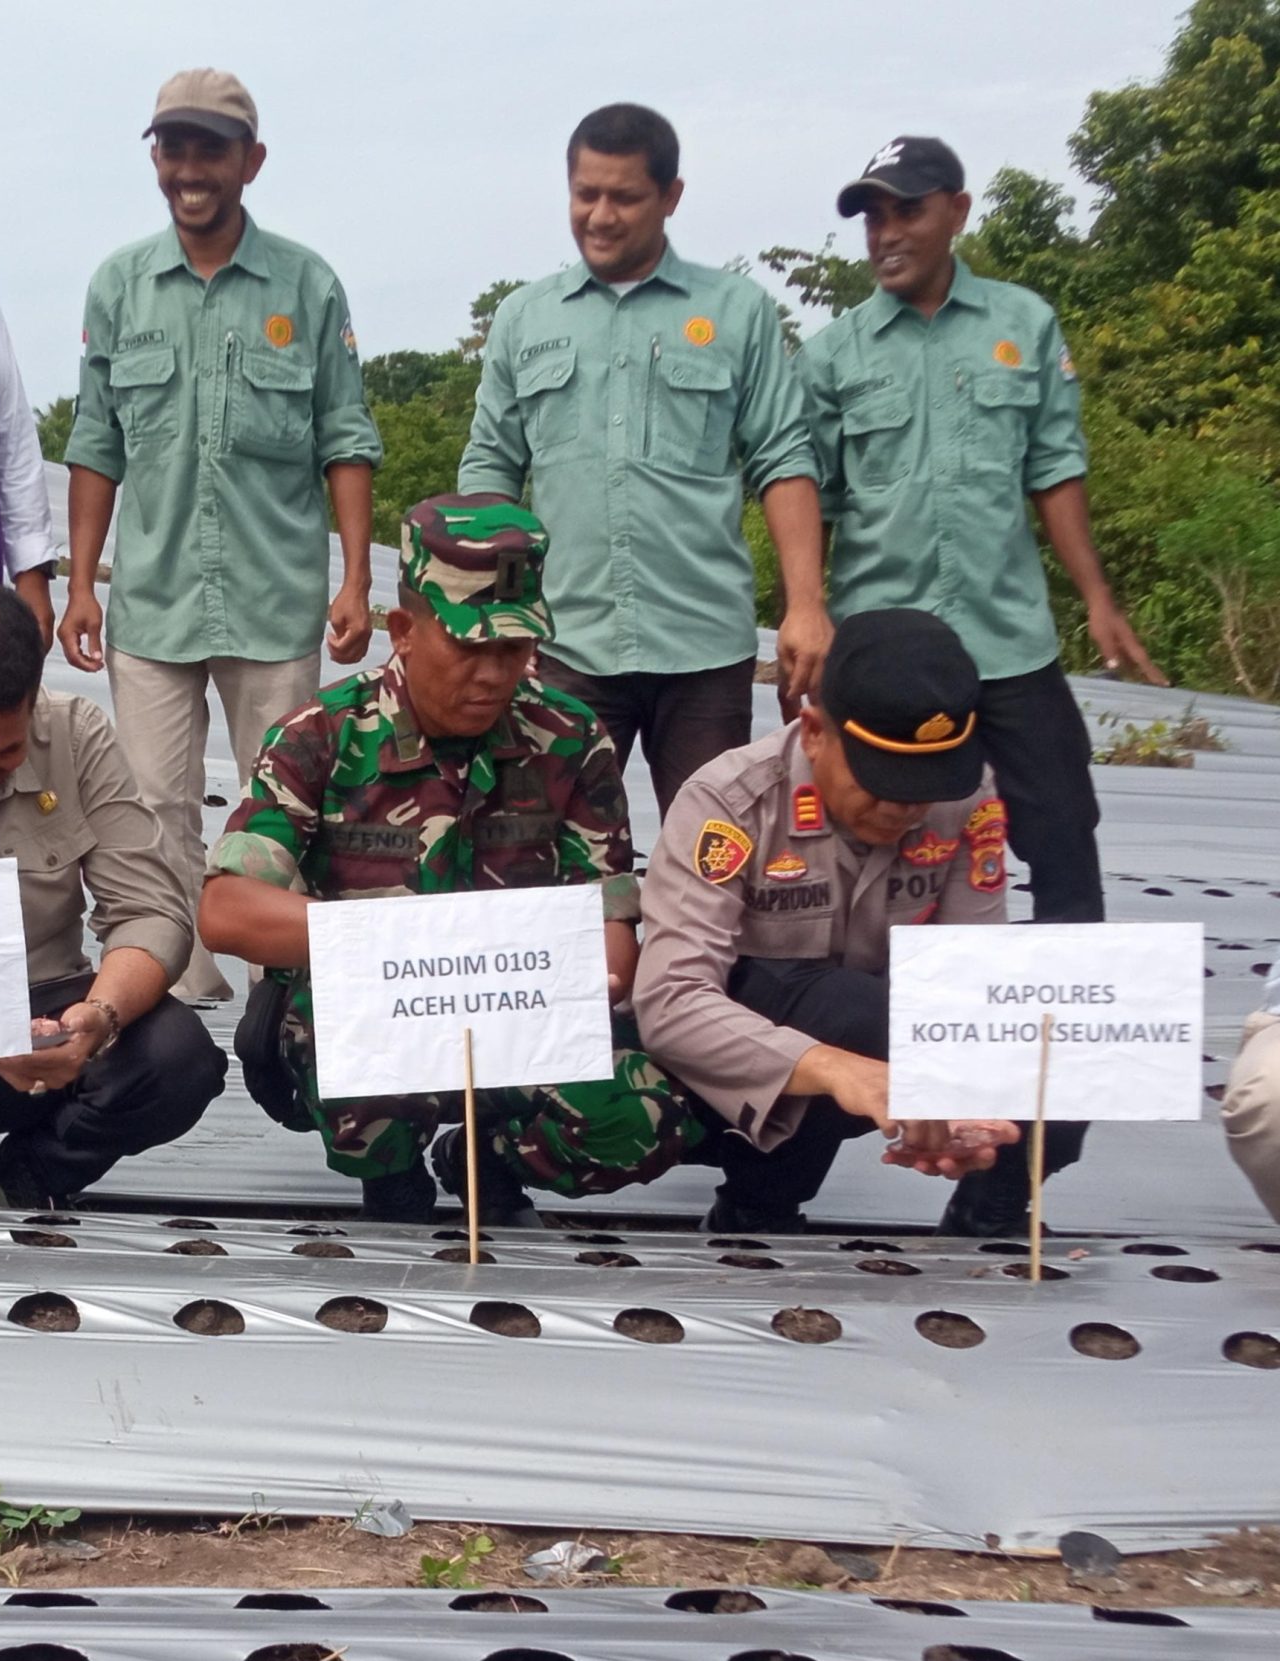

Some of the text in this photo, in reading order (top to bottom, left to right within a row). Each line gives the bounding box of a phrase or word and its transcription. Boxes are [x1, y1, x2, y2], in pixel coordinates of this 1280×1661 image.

[382, 949, 552, 981] DANDIM 0103
[391, 989, 548, 1019] ACEH UTARA
[986, 984, 1117, 1005] KAPOLRES
[911, 1022, 981, 1043] KOTA
